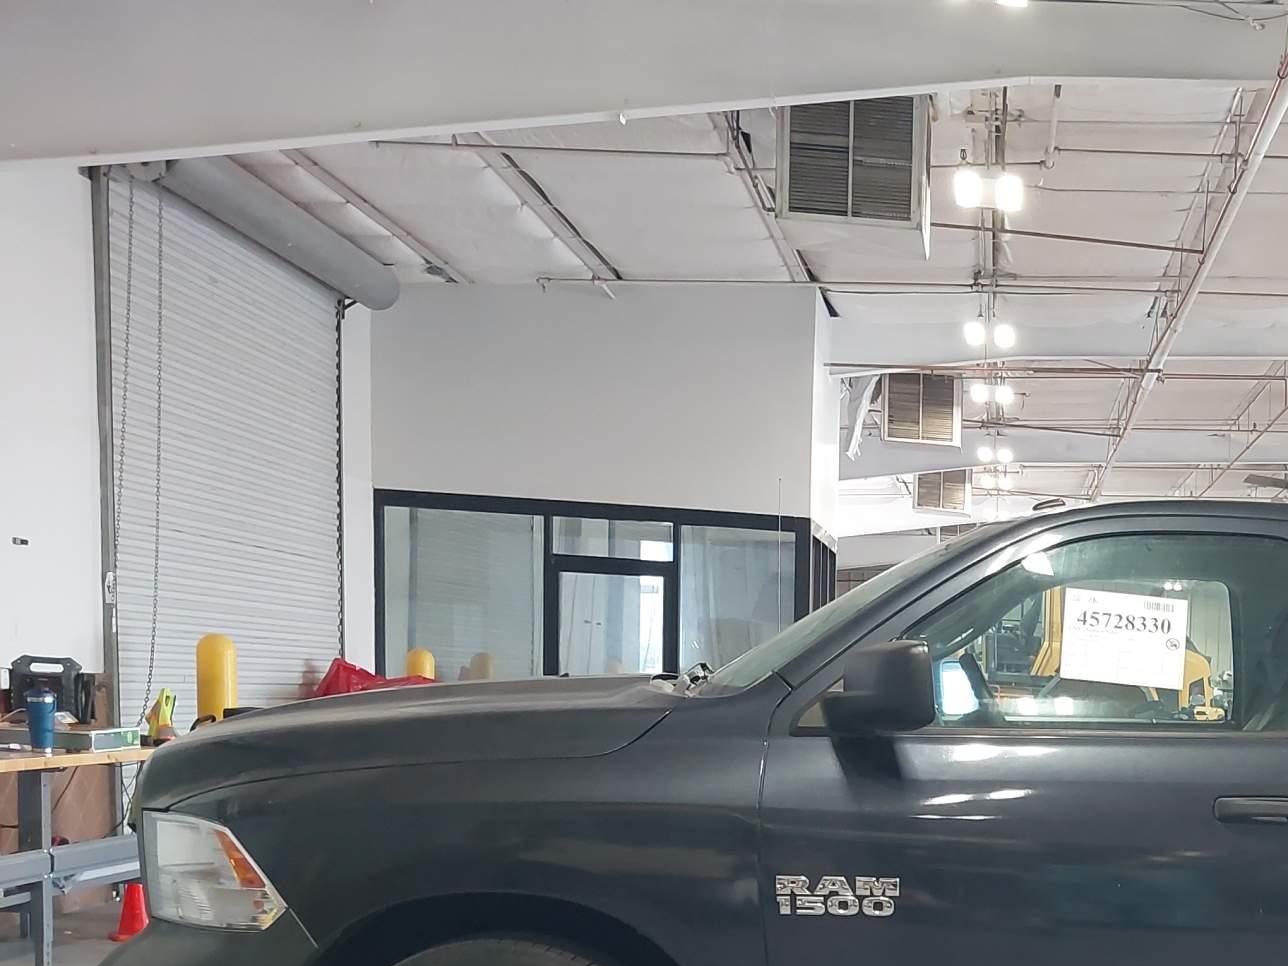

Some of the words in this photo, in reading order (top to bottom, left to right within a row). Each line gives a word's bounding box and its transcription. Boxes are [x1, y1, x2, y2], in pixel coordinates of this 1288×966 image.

[1077, 610, 1171, 635] 45728330
[775, 875, 900, 896] RAM
[776, 896, 895, 917] 1500
